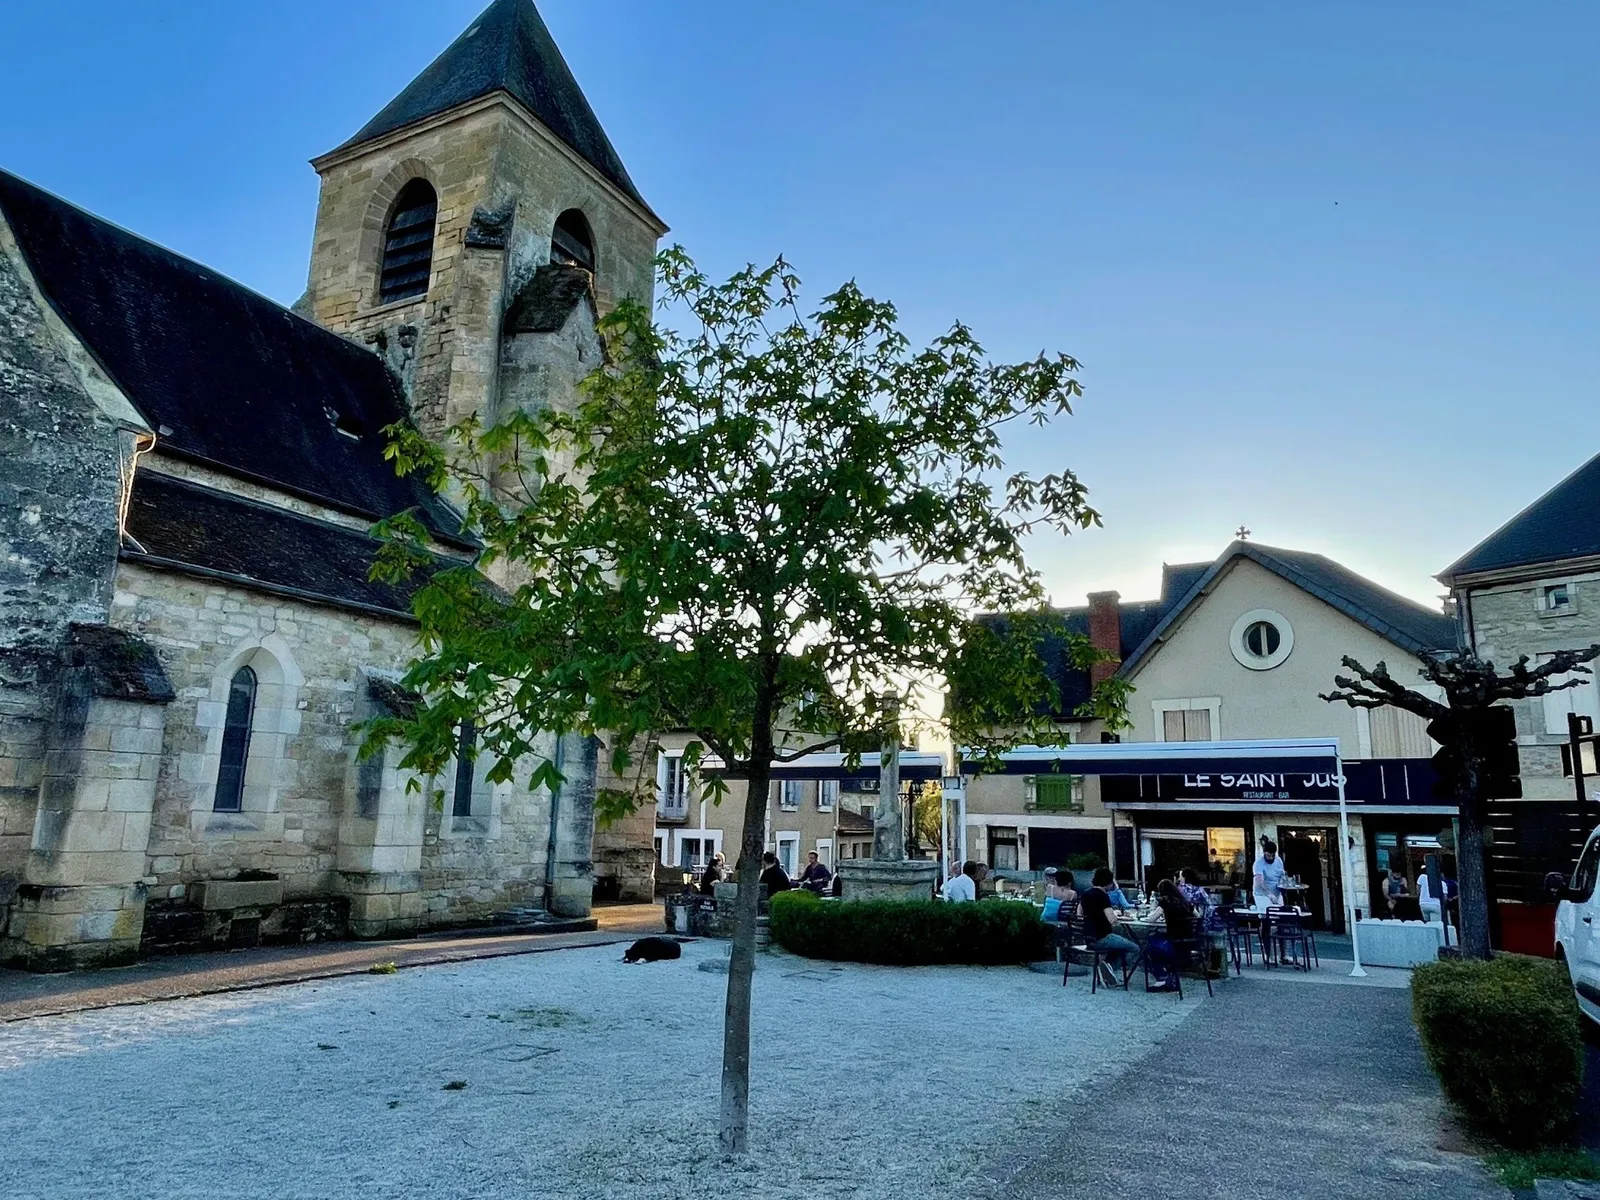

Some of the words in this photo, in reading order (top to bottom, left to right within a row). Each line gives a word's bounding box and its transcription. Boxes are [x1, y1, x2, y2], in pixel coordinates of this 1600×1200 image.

[1184, 774, 1211, 787] LE
[1243, 791, 1274, 799] RESTAURANT
[1278, 791, 1289, 799] BAR
